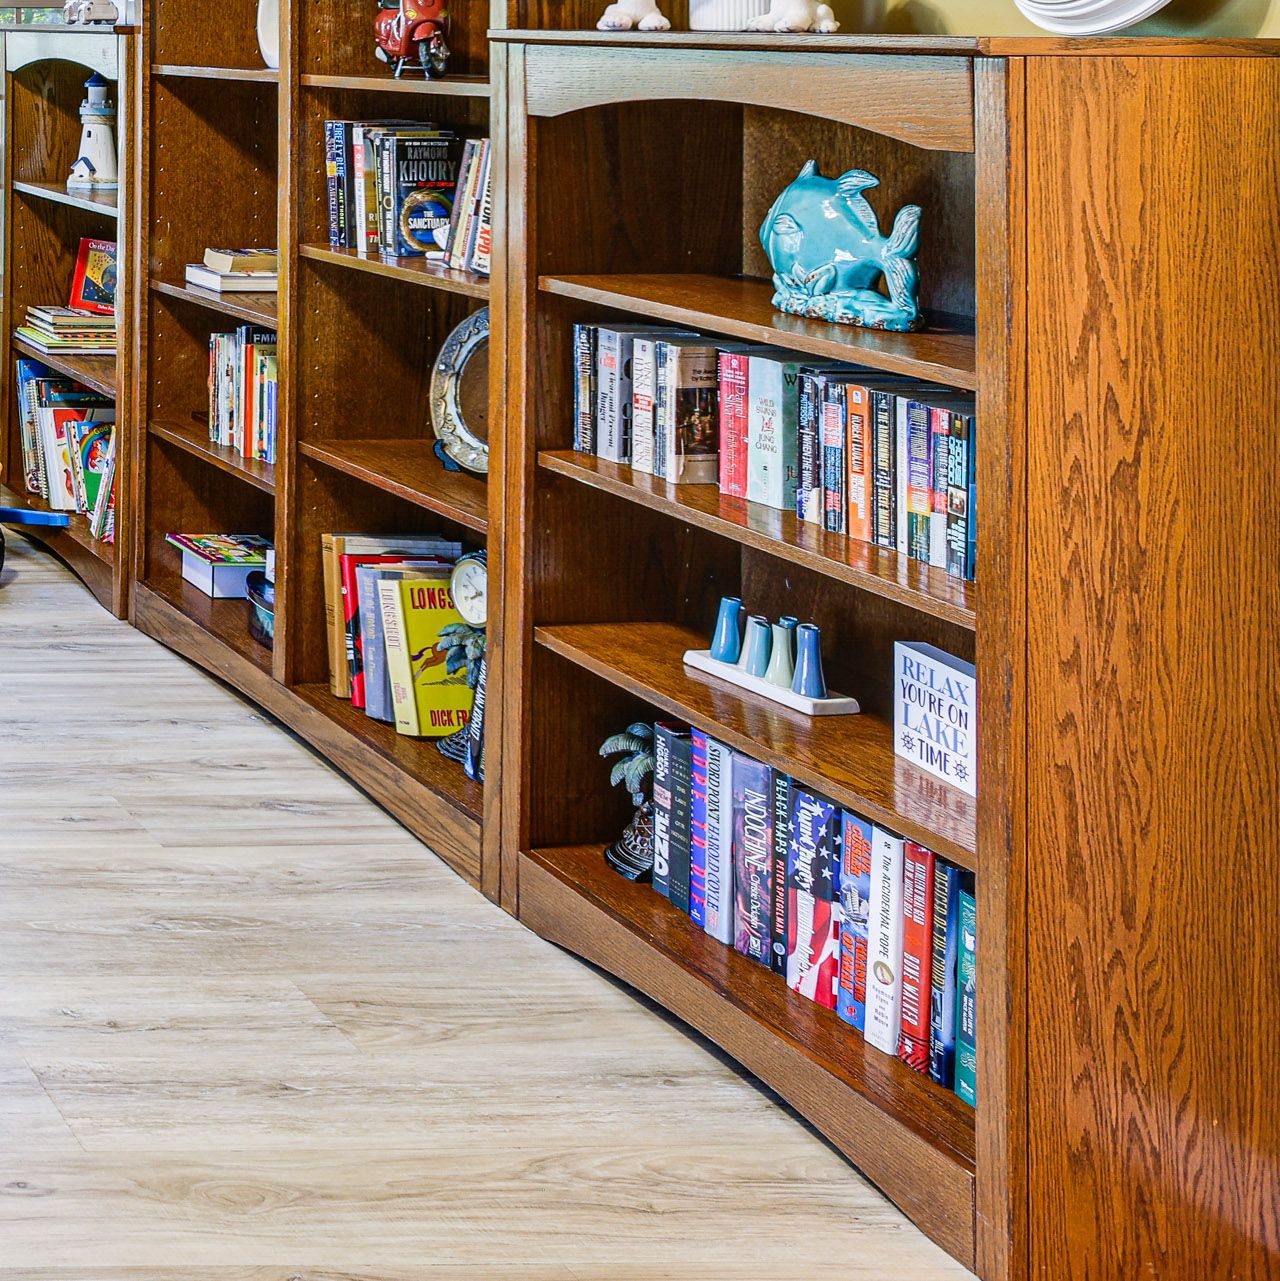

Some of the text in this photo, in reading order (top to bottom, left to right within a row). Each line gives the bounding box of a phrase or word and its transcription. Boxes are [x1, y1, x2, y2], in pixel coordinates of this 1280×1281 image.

[334, 123, 343, 156] FIREFLY
[408, 147, 448, 159] RAYMOND
[336, 157, 345, 177] BLUE
[399, 161, 456, 181] KHOURY
[478, 226, 491, 255] XPD
[635, 357, 644, 390] FLYNN
[644, 361, 652, 388] VINCE
[599, 392, 608, 423] Danger
[608, 396, 616, 412] and
[724, 394, 736, 416] Silva
[735, 385, 746, 418] Daniel
[800, 394, 808, 426] PATTERSON
[608, 414, 616, 448] Present
[635, 414, 644, 463] OPTION
[851, 415, 863, 473] ROBERT LUDLUM
[948, 437, 955, 454] OF
[802, 435, 812, 490] WHEN THE WIND
[878, 488, 889, 509] STEVE
[878, 510, 889, 537] MARTINI
[411, 587, 454, 610] LONGS
[381, 588, 402, 652] LONGSHOT
[901, 655, 970, 707] RELAX
[430, 710, 455, 727] DICK
[901, 679, 968, 730] YOU'RE ON
[902, 702, 969, 759] LAKE
[656, 735, 665, 782] HIGSON
[917, 737, 951, 776] TIME
[692, 735, 707, 908] HOPE TO DIE
[707, 746, 721, 912] SWORD POINT HAROLD COYLE
[744, 788, 767, 876] INDOCHINE
[799, 799, 820, 835] Tom
[775, 778, 787, 935] BLACK MAPS PETER SPIEGELMAN
[794, 833, 816, 893] Clancy
[850, 825, 862, 877] CUSSLER
[861, 838, 871, 874] CLIVE
[882, 854, 892, 871] The
[750, 874, 760, 900] Christie
[904, 878, 914, 904] MICHAEL
[915, 863, 927, 892] KATHLEEN
[904, 903, 913, 919] GEAR
[879, 932, 889, 959] POPE
[931, 869, 948, 990] OFFICER OF THE COURT
[840, 932, 854, 993] OF KHAN
[854, 936, 867, 1002] TREASURE
[902, 952, 920, 1026] BONE WALKER
[935, 1040, 944, 1055] BILL
